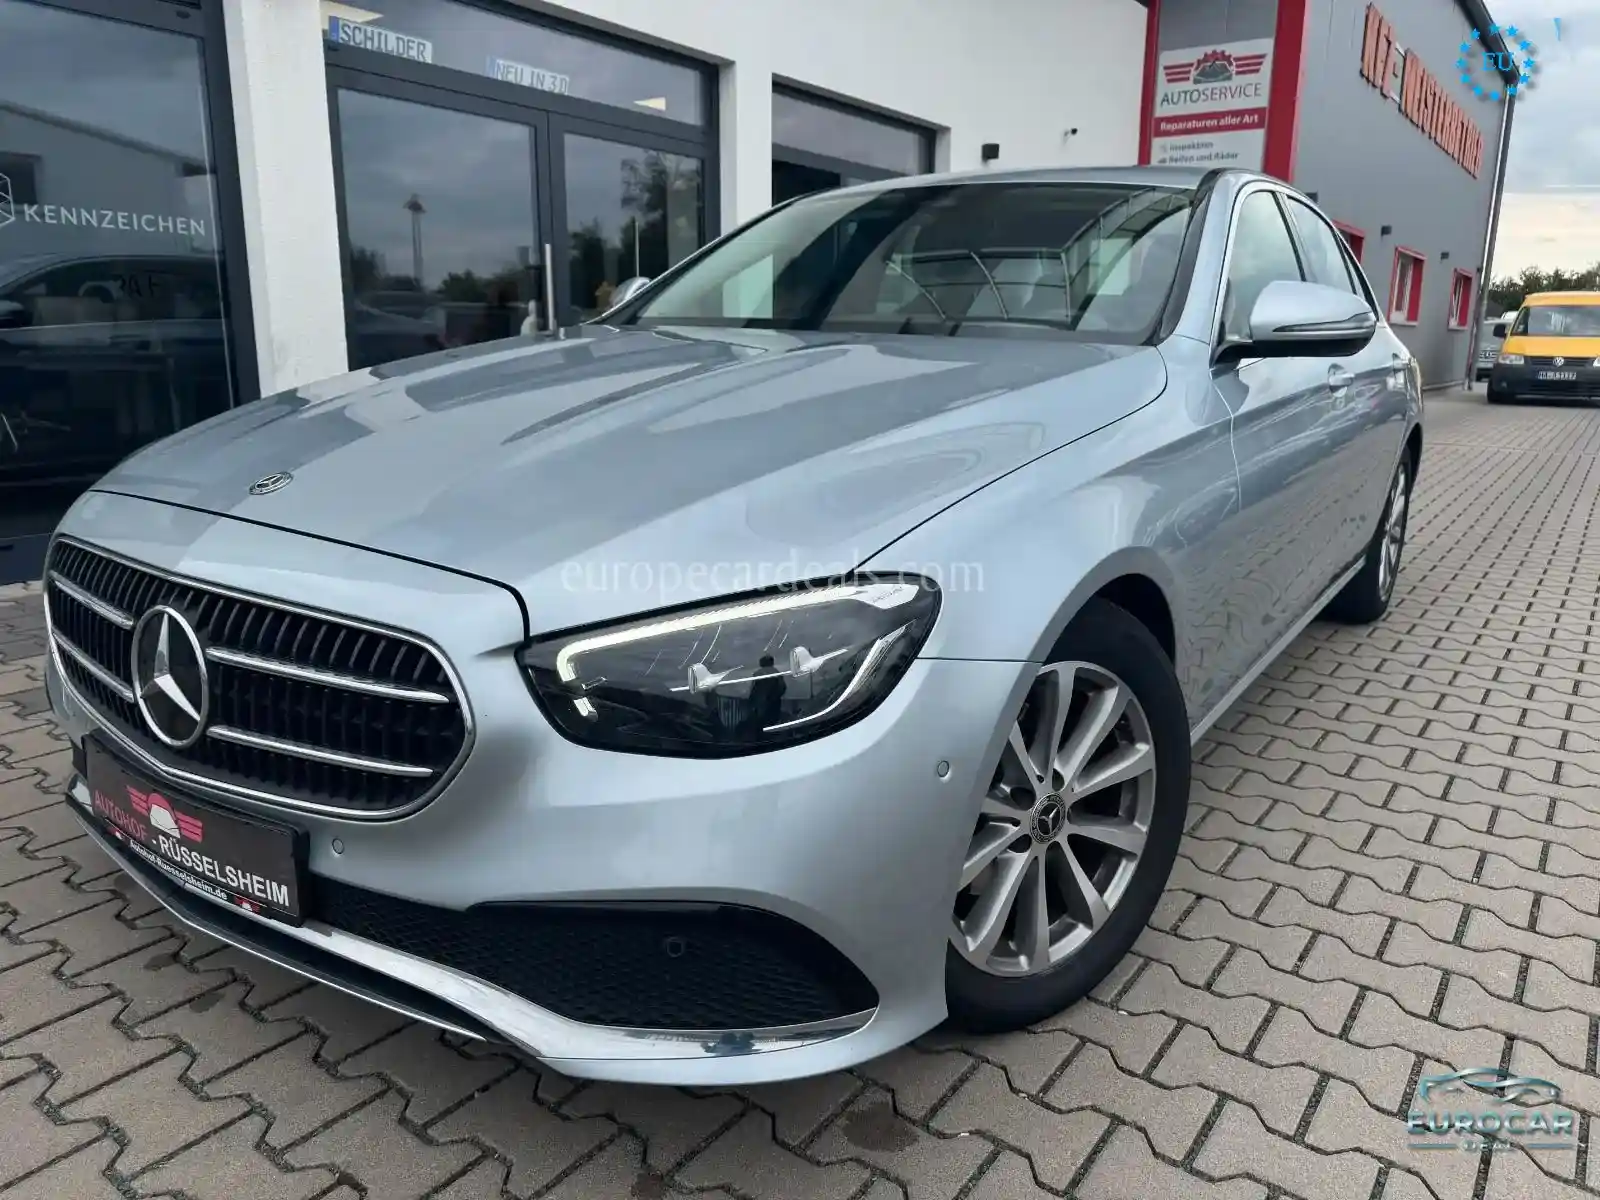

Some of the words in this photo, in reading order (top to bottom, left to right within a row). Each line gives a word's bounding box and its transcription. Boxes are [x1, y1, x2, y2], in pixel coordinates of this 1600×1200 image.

[340, 22, 427, 61] SCHILDER
[529, 71, 545, 90] IN
[1160, 83, 1262, 107] AUTOSERVICE
[1160, 116, 1217, 131] Reparaturen
[1219, 114, 1241, 126] aller
[1242, 113, 1259, 124] Art
[23, 203, 206, 236] KENNZEICHEN
[93, 789, 149, 842] AUTOHOF
[158, 834, 291, 907] RÜSSELSHEIM
[129, 838, 228, 901] Autohof-Ruesselsheim.de
